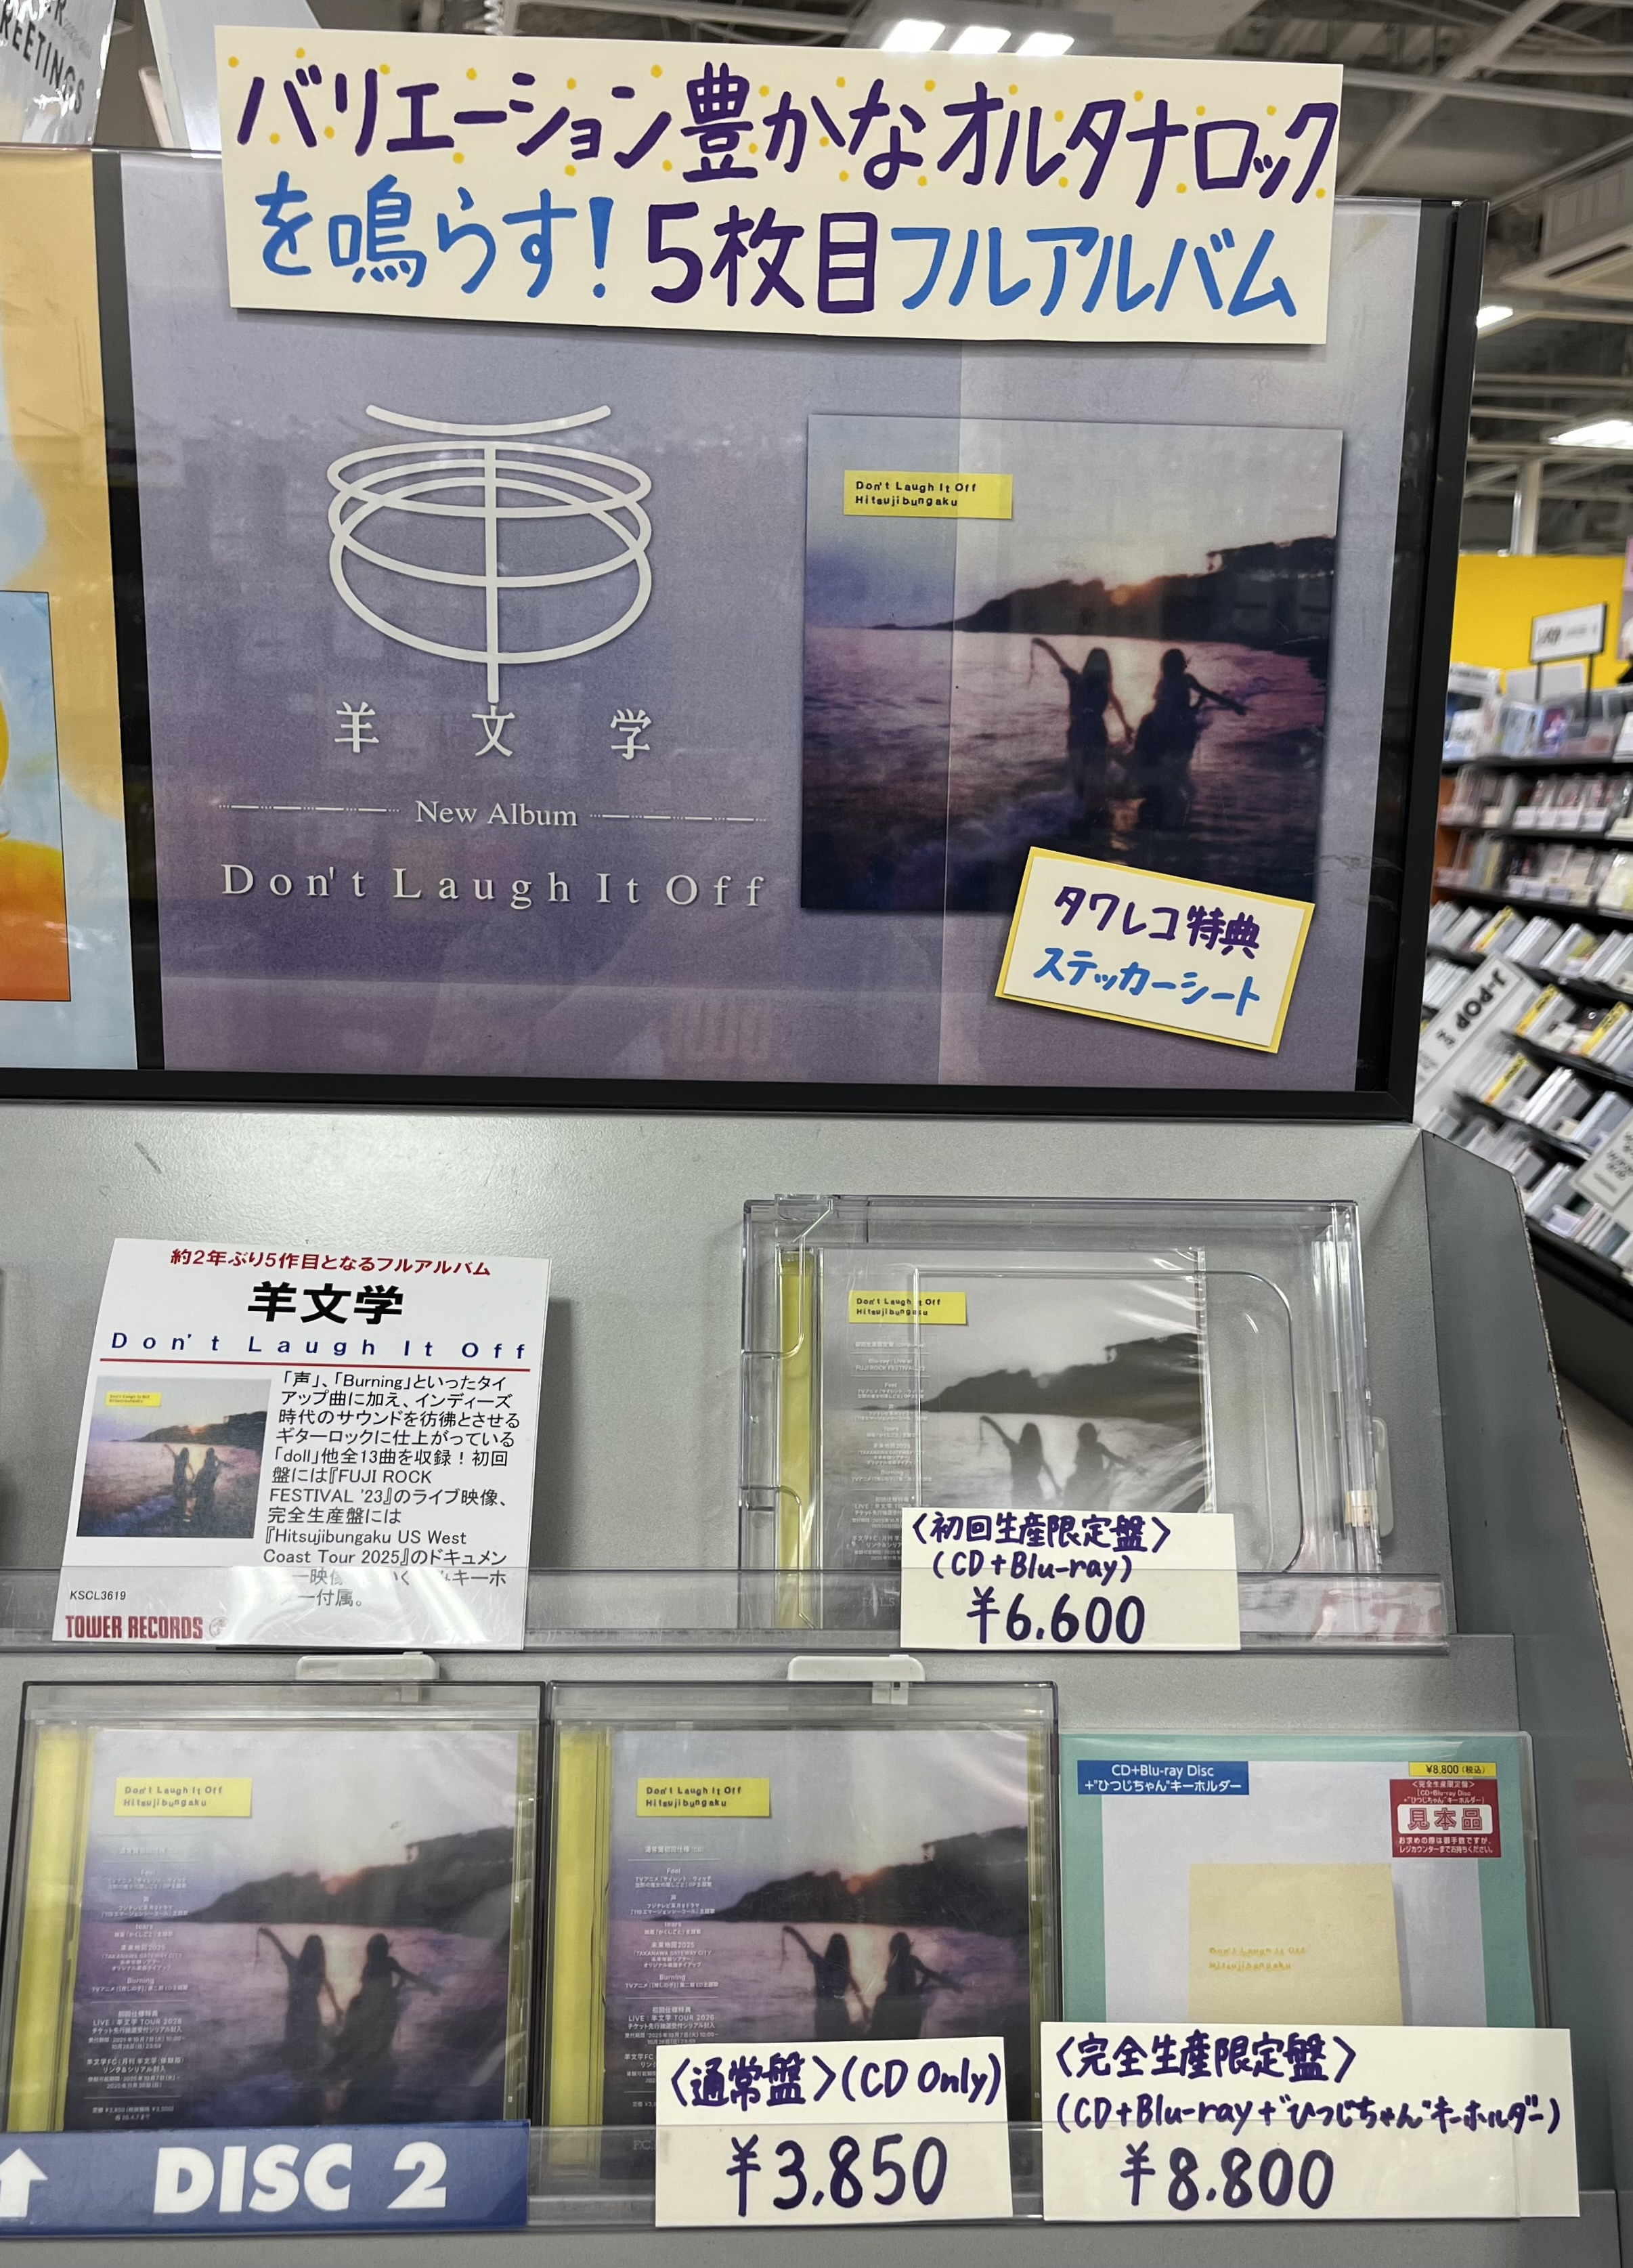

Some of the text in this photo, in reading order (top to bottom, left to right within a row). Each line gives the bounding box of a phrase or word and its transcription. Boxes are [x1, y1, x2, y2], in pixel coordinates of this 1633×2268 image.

[237, 61, 1338, 209] バリエーション豊かなオルタナロック
[856, 481, 977, 494] Don't Laugh It Off
[855, 495, 958, 507] Hitsujibungaku
[415, 800, 579, 827] New Album
[221, 863, 766, 911] Don't Laugh It Off
[1054, 886, 1261, 959] タワレコ特典
[1033, 947, 1260, 1016] ステッカーシート
[171, 1248, 492, 1277] 約2年ぶり5作目となるフルアルバム
[247, 1281, 404, 1325] 羊文学
[884, 1298, 911, 1306] Laugh
[111, 1332, 525, 1360] Don't Laugh It Off
[281, 1390, 513, 1409] アップ曲に加え、インディーズ
[278, 1409, 520, 1428] 時代のサウンドを彷彿とさせる
[276, 1429, 515, 1447] ギターロックに仕上がっている
[383, 1470, 432, 1484] ROCK
[269, 1489, 353, 1502] FESTIVAL
[268, 1507, 401, 1524] 完全生産盤には
[397, 1530, 421, 1543] US
[427, 1530, 466, 1544] West
[263, 1549, 311, 1564] Coast
[318, 1549, 355, 1564] Tour
[70, 1591, 127, 1600] KSCL3619
[66, 1615, 203, 1639] TOWER RECORDS
[1112, 1763, 1215, 1779] CD+Blu-ray Disc
[125, 1786, 152, 1795] Don't
[156, 1786, 188, 1795] Laugh
[204, 1786, 222, 1795] Off
[647, 1786, 672, 1795] Don't
[678, 1786, 707, 1796] Laugh
[724, 1786, 741, 1795] Off
[124, 1799, 206, 1808] Hitsujibungaku
[646, 1798, 726, 1809] Hitsujibungaku
[1408, 1807, 1483, 1831] 見本品
[659, 1973, 686, 1982] Burning
[152, 2140, 448, 2214] DISC 2
